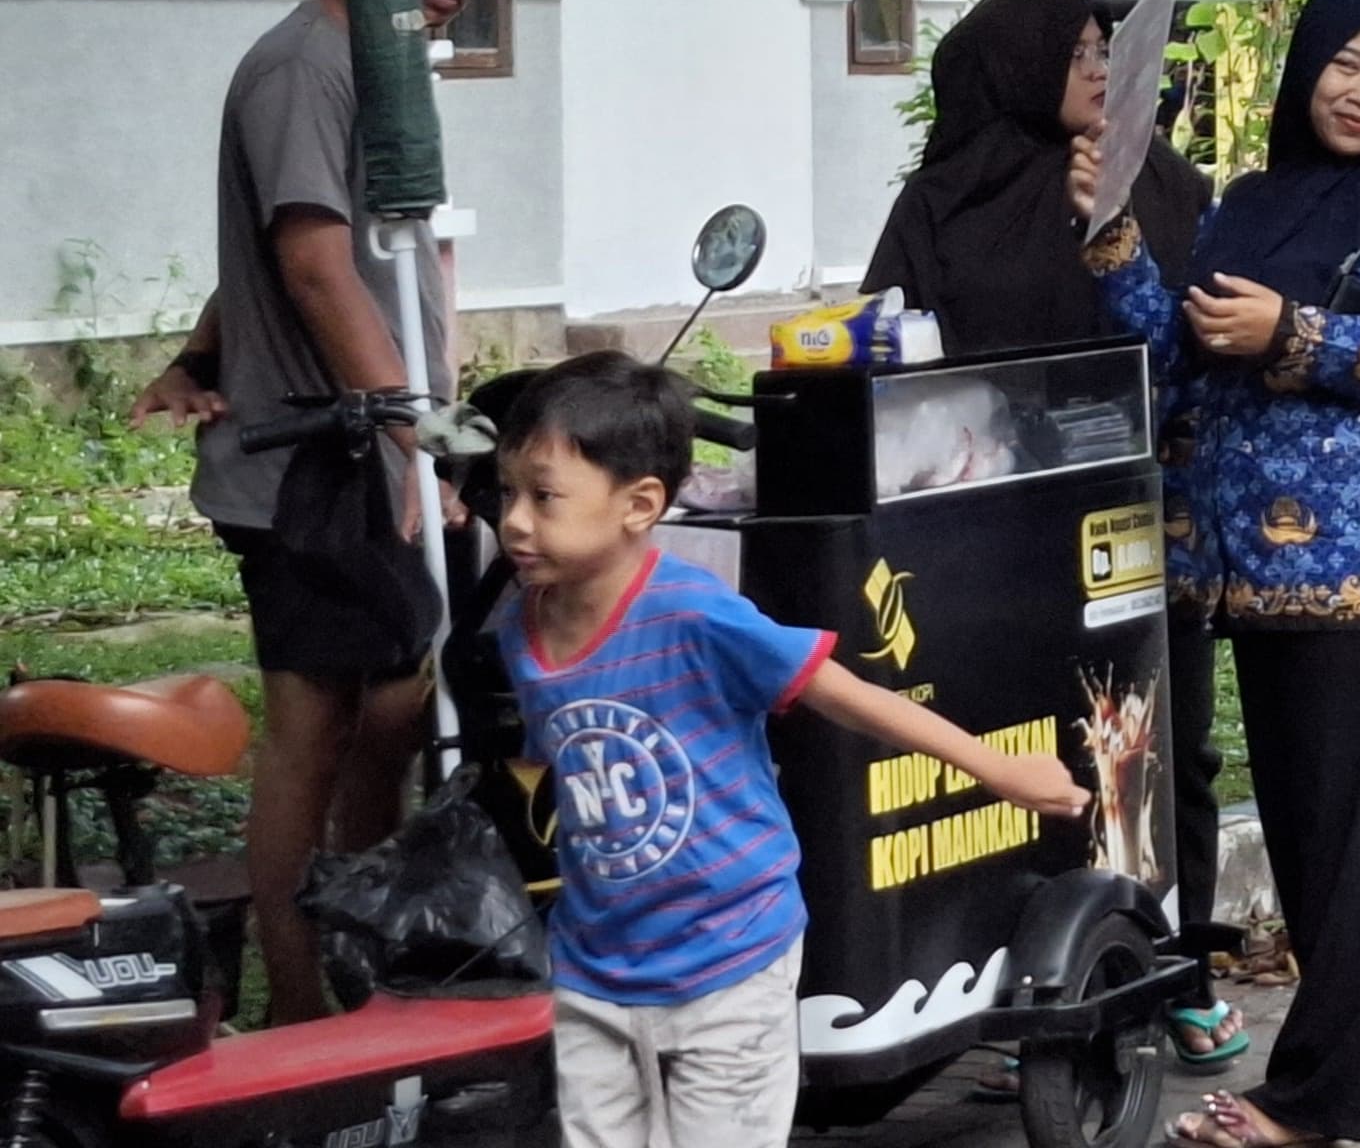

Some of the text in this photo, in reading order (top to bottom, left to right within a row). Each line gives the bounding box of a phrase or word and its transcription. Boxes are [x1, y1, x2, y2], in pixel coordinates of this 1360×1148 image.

[869, 752, 942, 816] HIDUP
[871, 824, 929, 891] KOPI
[931, 800, 1029, 872] MAINKAN
